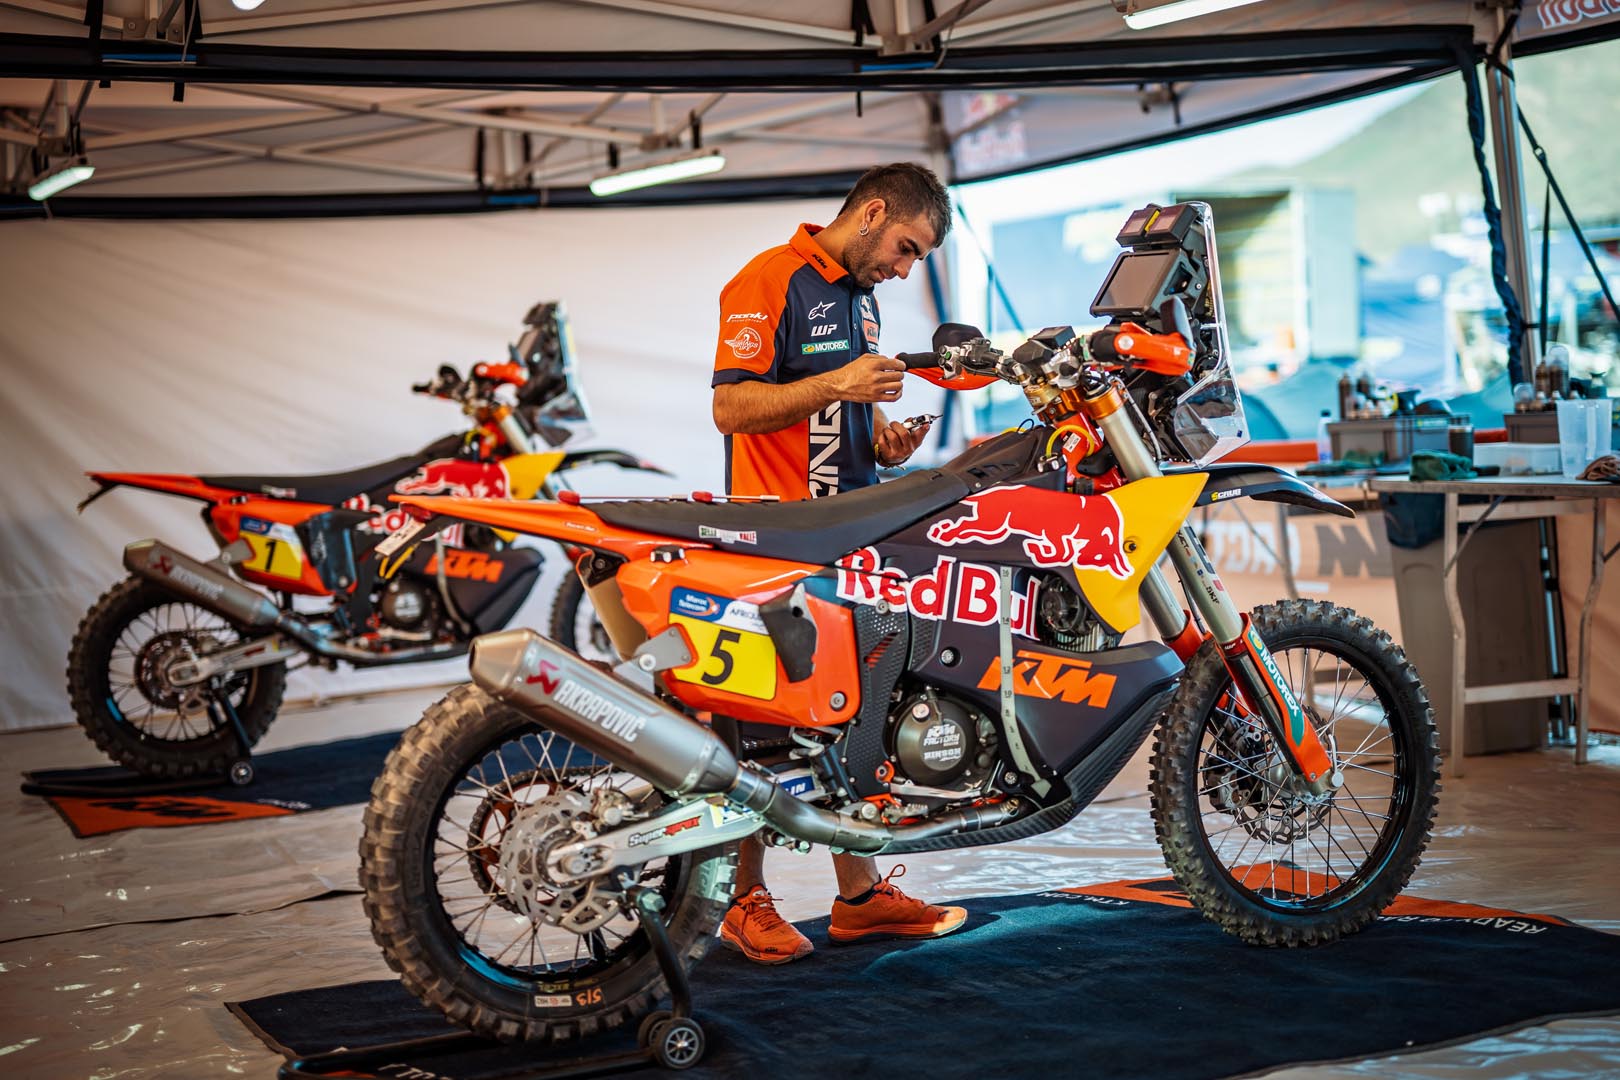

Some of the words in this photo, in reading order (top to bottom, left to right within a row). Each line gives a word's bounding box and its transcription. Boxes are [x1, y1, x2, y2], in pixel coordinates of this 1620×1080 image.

[811, 324, 838, 337] WP
[815, 340, 847, 352] MOTOREX
[265, 540, 277, 572] 1
[424, 549, 505, 583] KTM
[701, 629, 742, 685] 5
[977, 649, 1117, 709] KTM
[1260, 648, 1300, 717] MOTOREX
